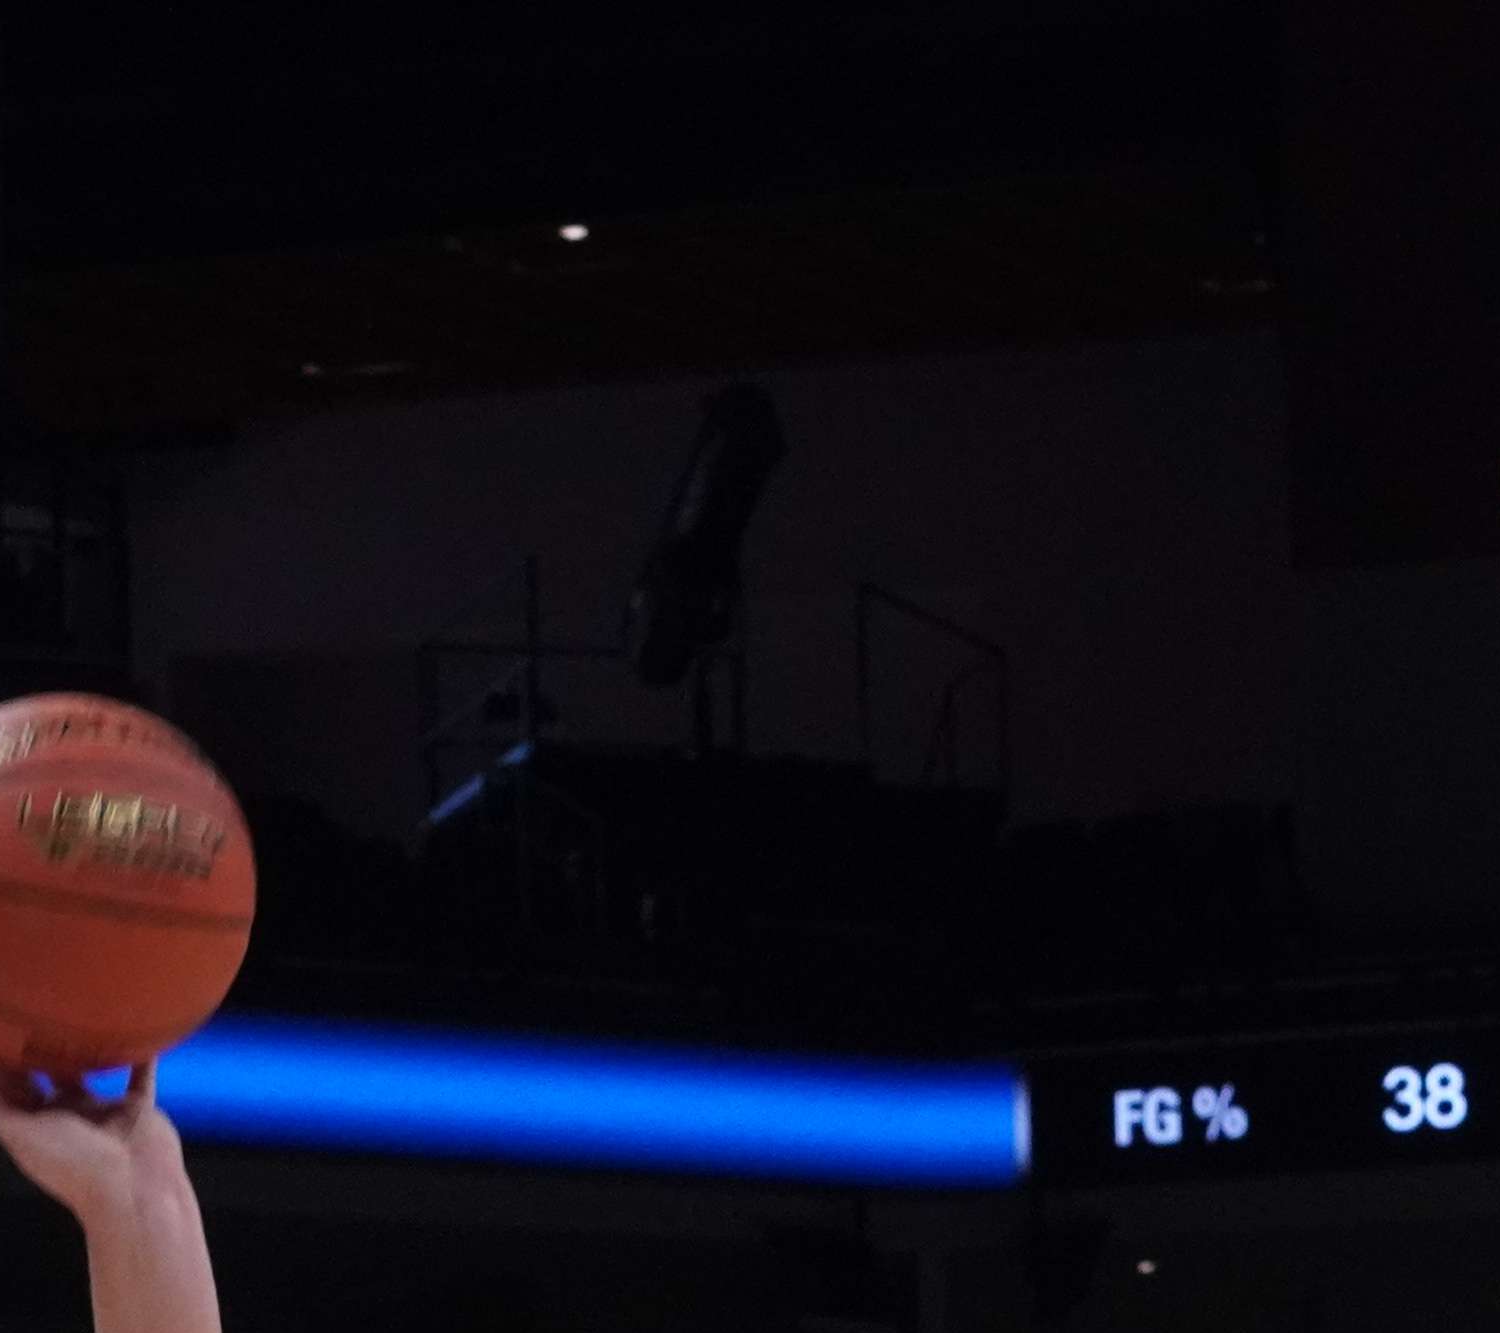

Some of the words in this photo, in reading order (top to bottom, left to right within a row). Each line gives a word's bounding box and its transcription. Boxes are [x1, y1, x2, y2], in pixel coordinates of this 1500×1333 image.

[1112, 1085, 1184, 1148] FG
[1191, 1082, 1249, 1142] %
[1381, 1061, 1469, 1133] 38
